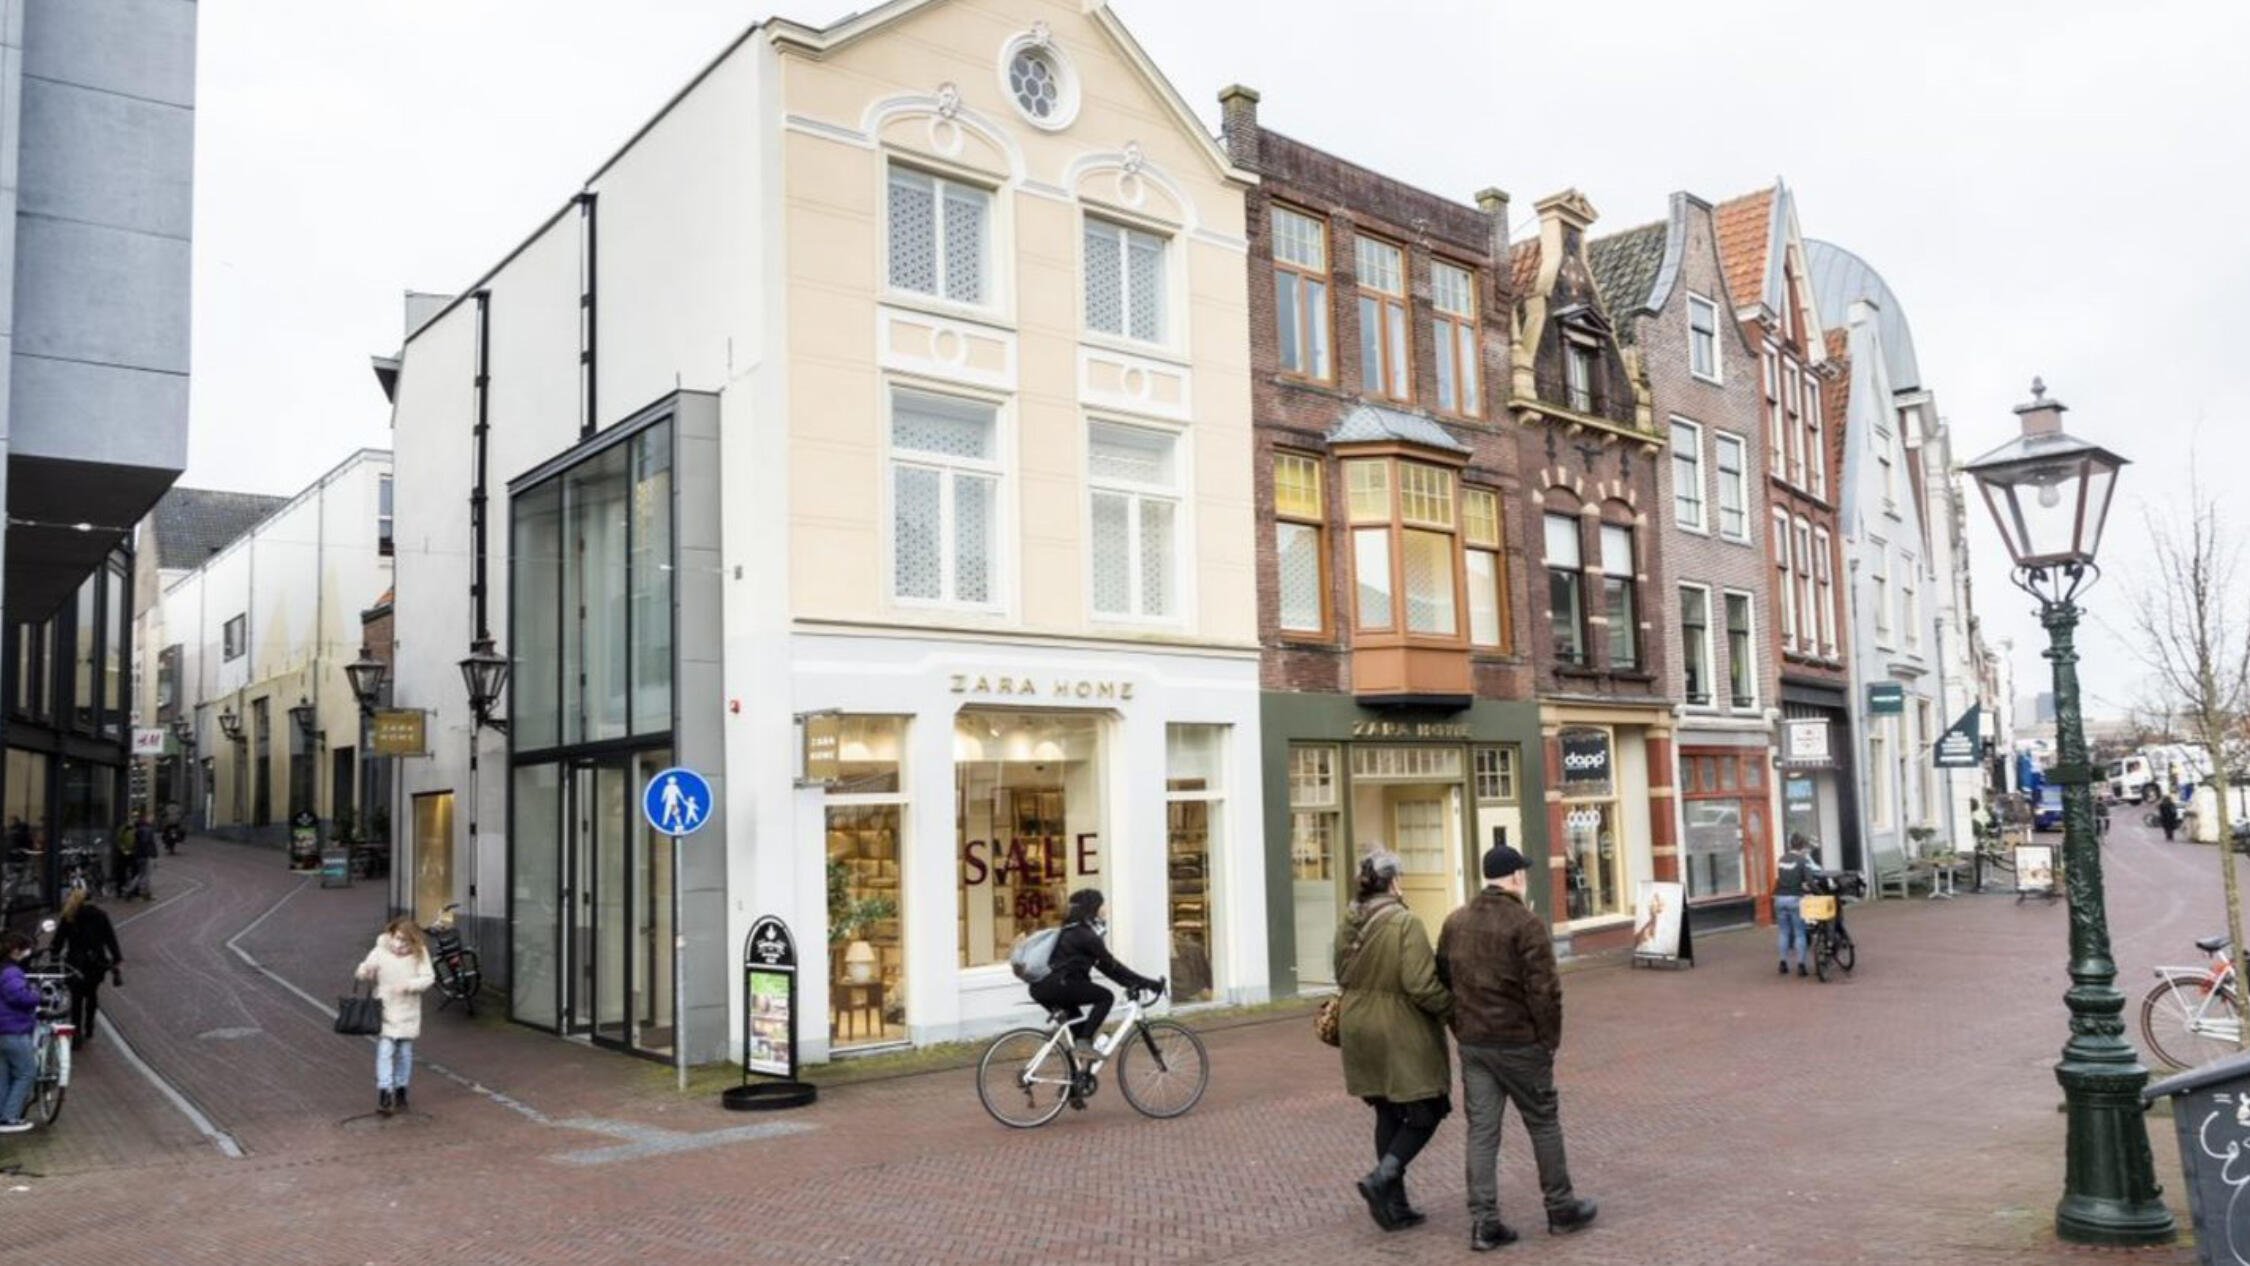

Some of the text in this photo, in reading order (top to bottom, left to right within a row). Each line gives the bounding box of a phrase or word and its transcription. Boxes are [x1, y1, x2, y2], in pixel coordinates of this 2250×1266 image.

[950, 674, 1134, 700] ZARA HOME
[1352, 720, 1472, 738] ZARA HOME
[964, 832, 1100, 886] SALE
